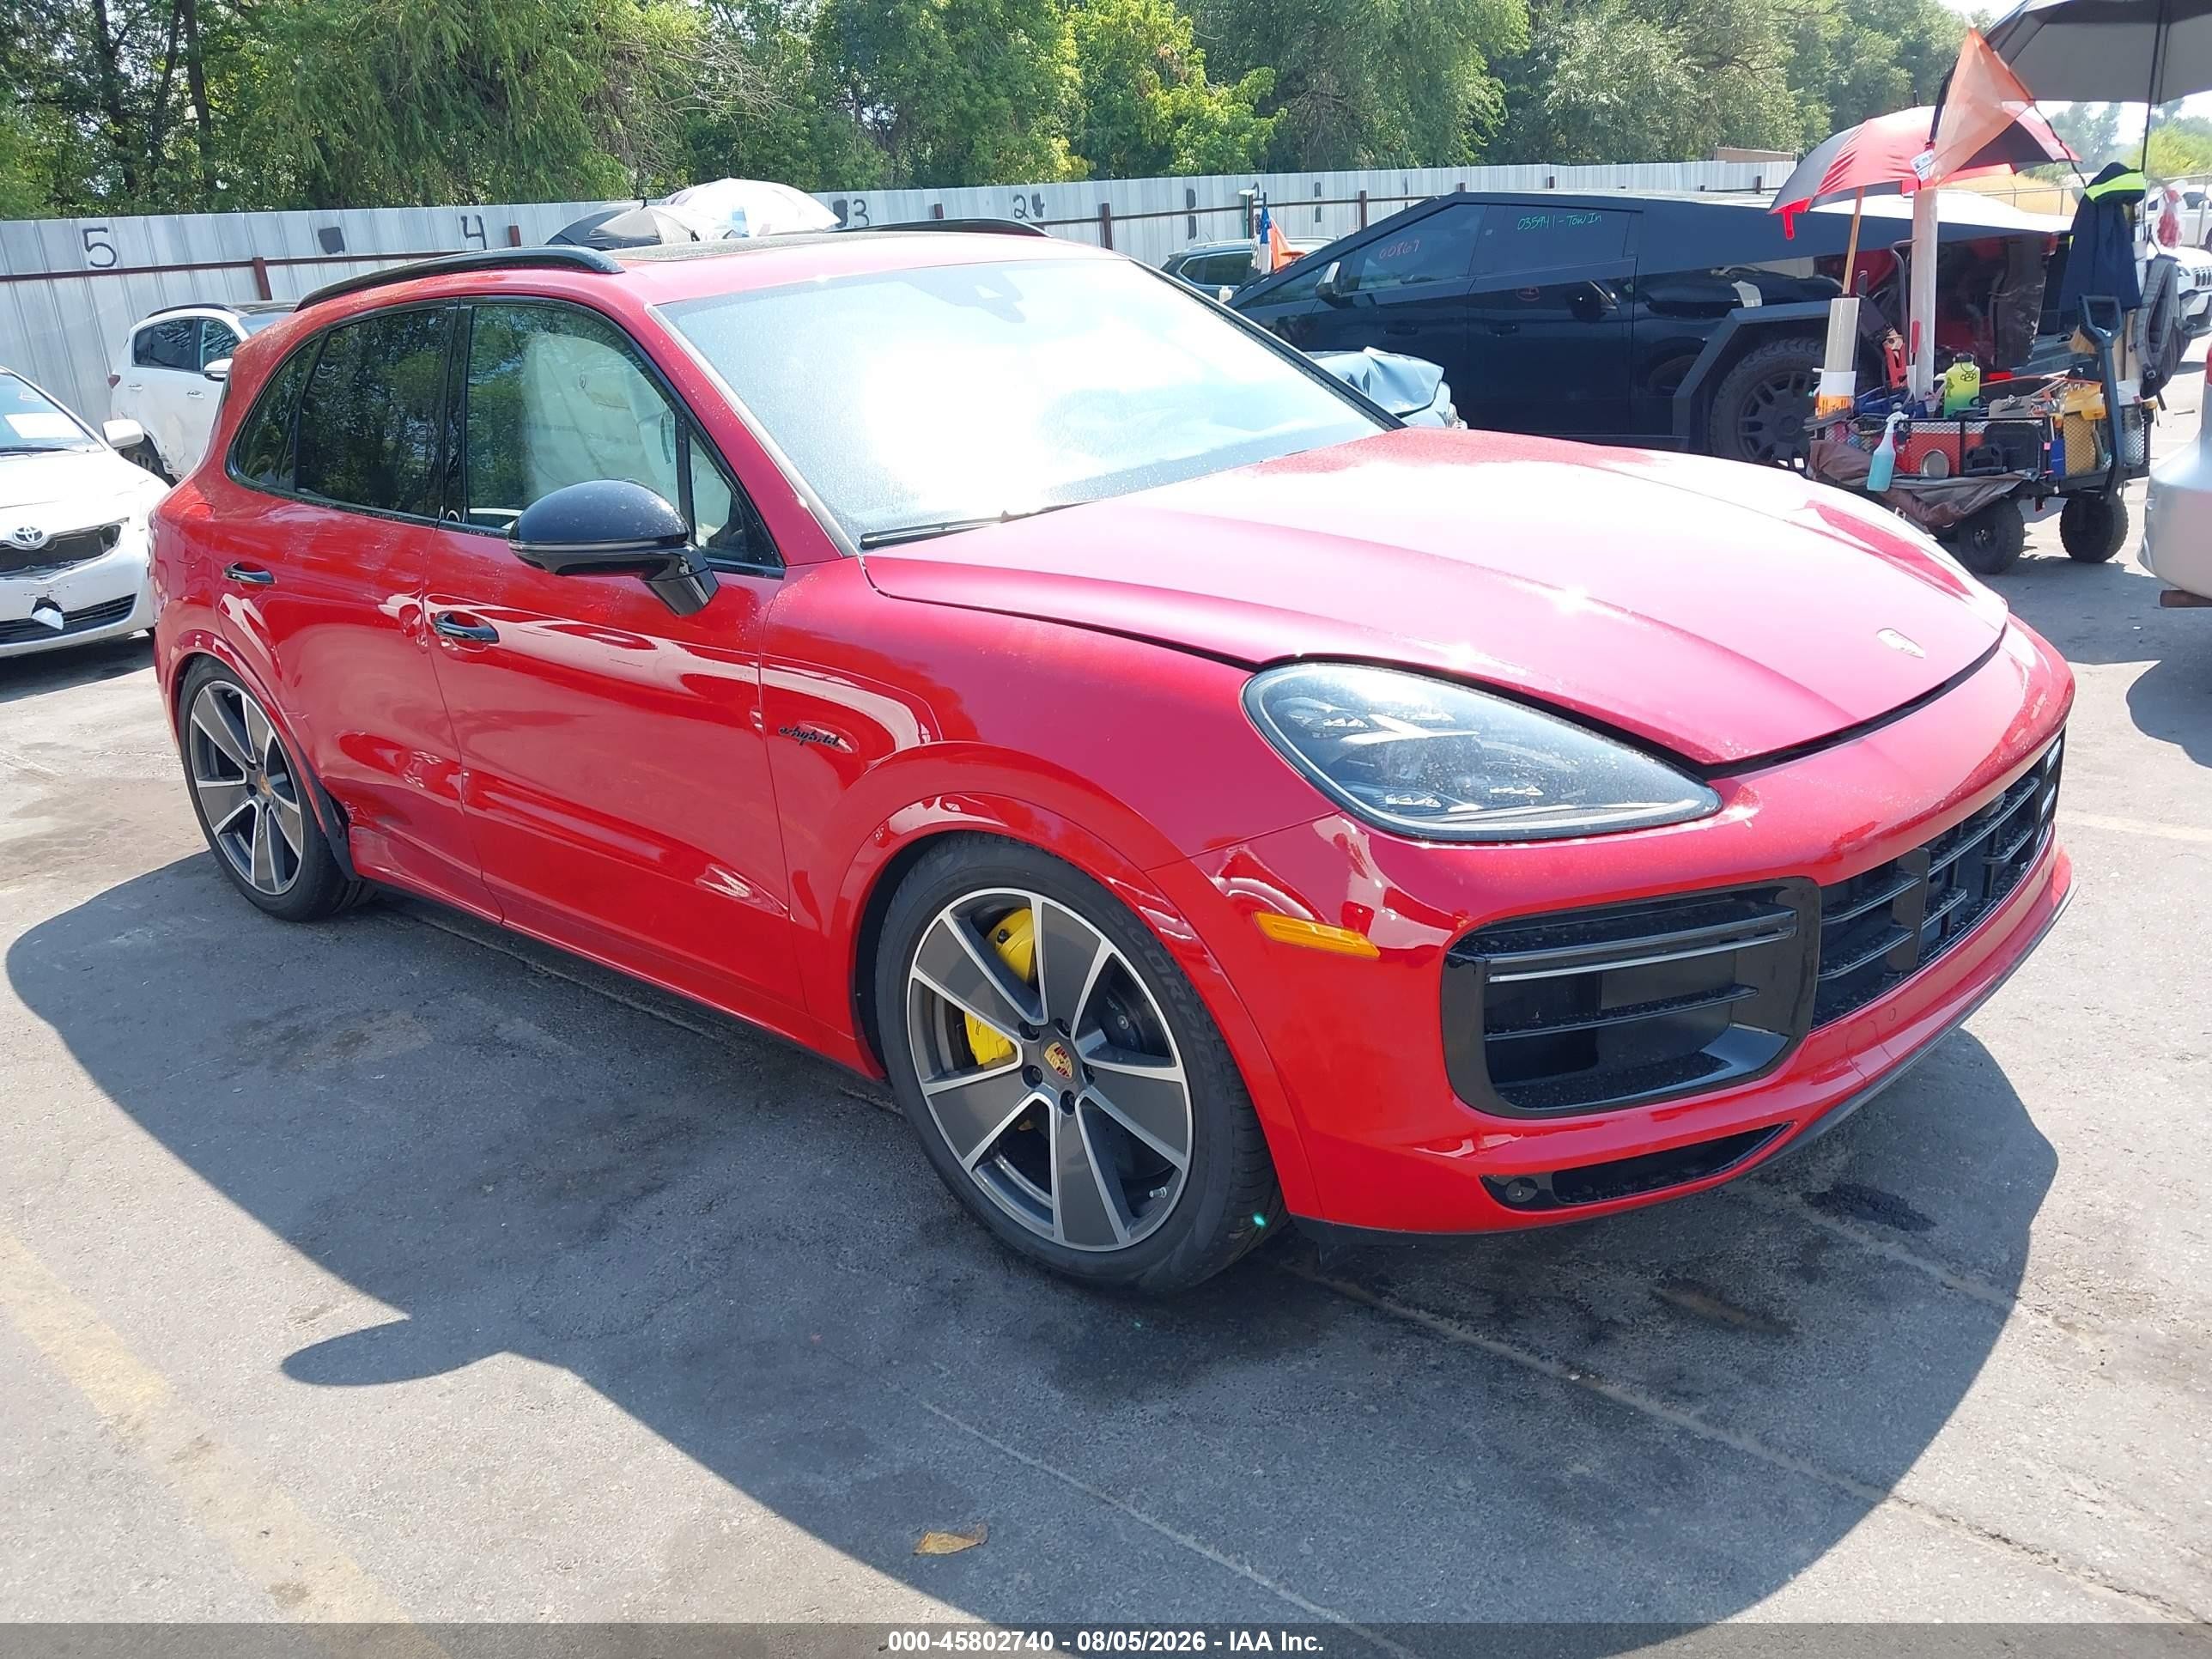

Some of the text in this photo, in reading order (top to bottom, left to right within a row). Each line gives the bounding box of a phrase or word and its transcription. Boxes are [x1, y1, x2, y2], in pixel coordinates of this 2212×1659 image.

[853, 198, 870, 227] 3
[82, 227, 117, 268] 5
[462, 215, 488, 250] 4
